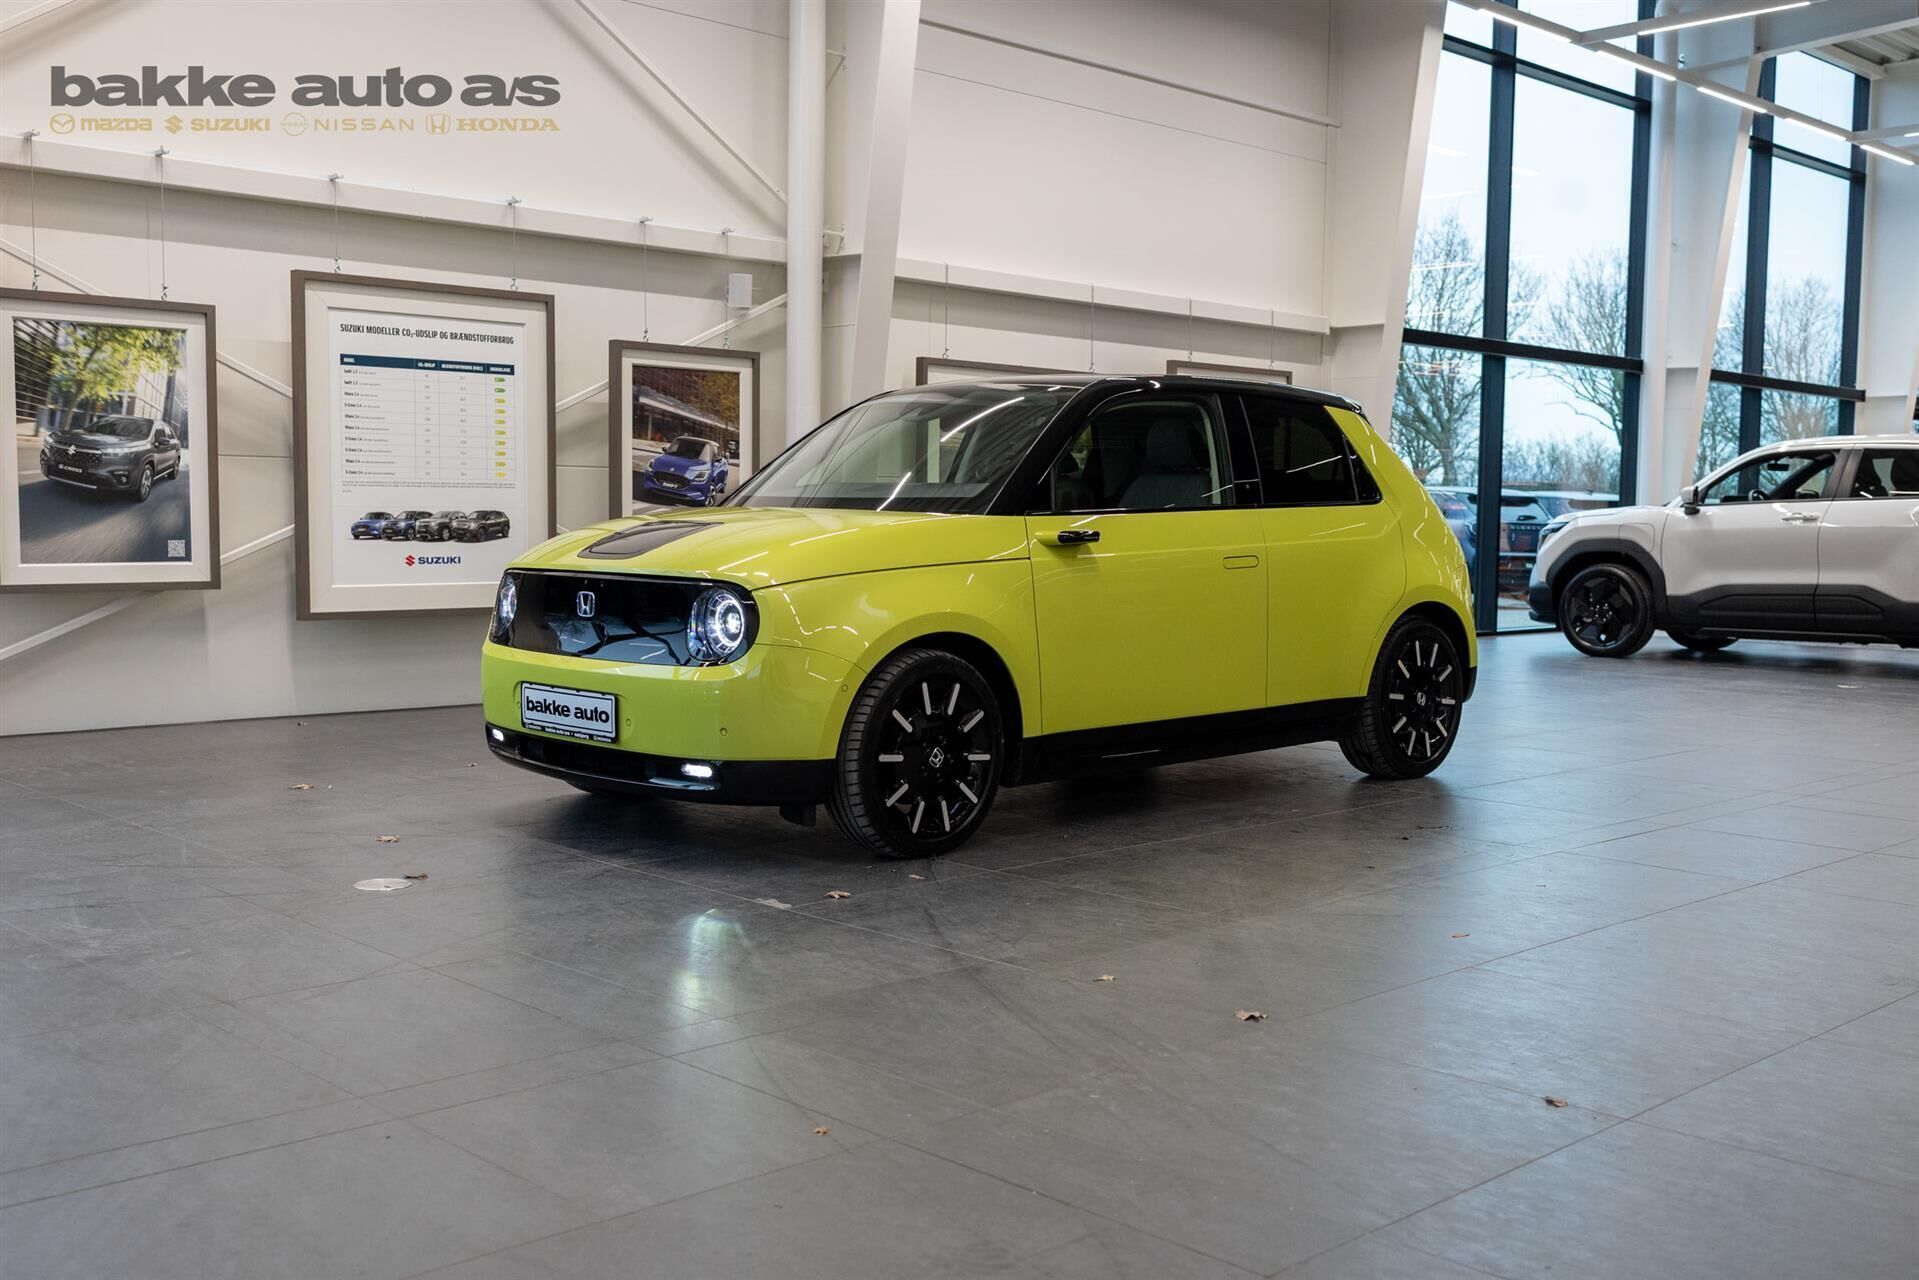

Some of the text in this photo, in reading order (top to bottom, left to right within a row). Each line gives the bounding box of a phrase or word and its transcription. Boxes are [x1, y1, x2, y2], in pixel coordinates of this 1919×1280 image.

[340, 323, 365, 333] SUZUKI
[366, 326, 400, 336] MODELLER
[439, 331, 448, 340] OG
[449, 332, 514, 344] BRÆNDSTOFFORBRUG
[418, 556, 461, 565] SUZUKI
[526, 696, 610, 723] bakke auto
